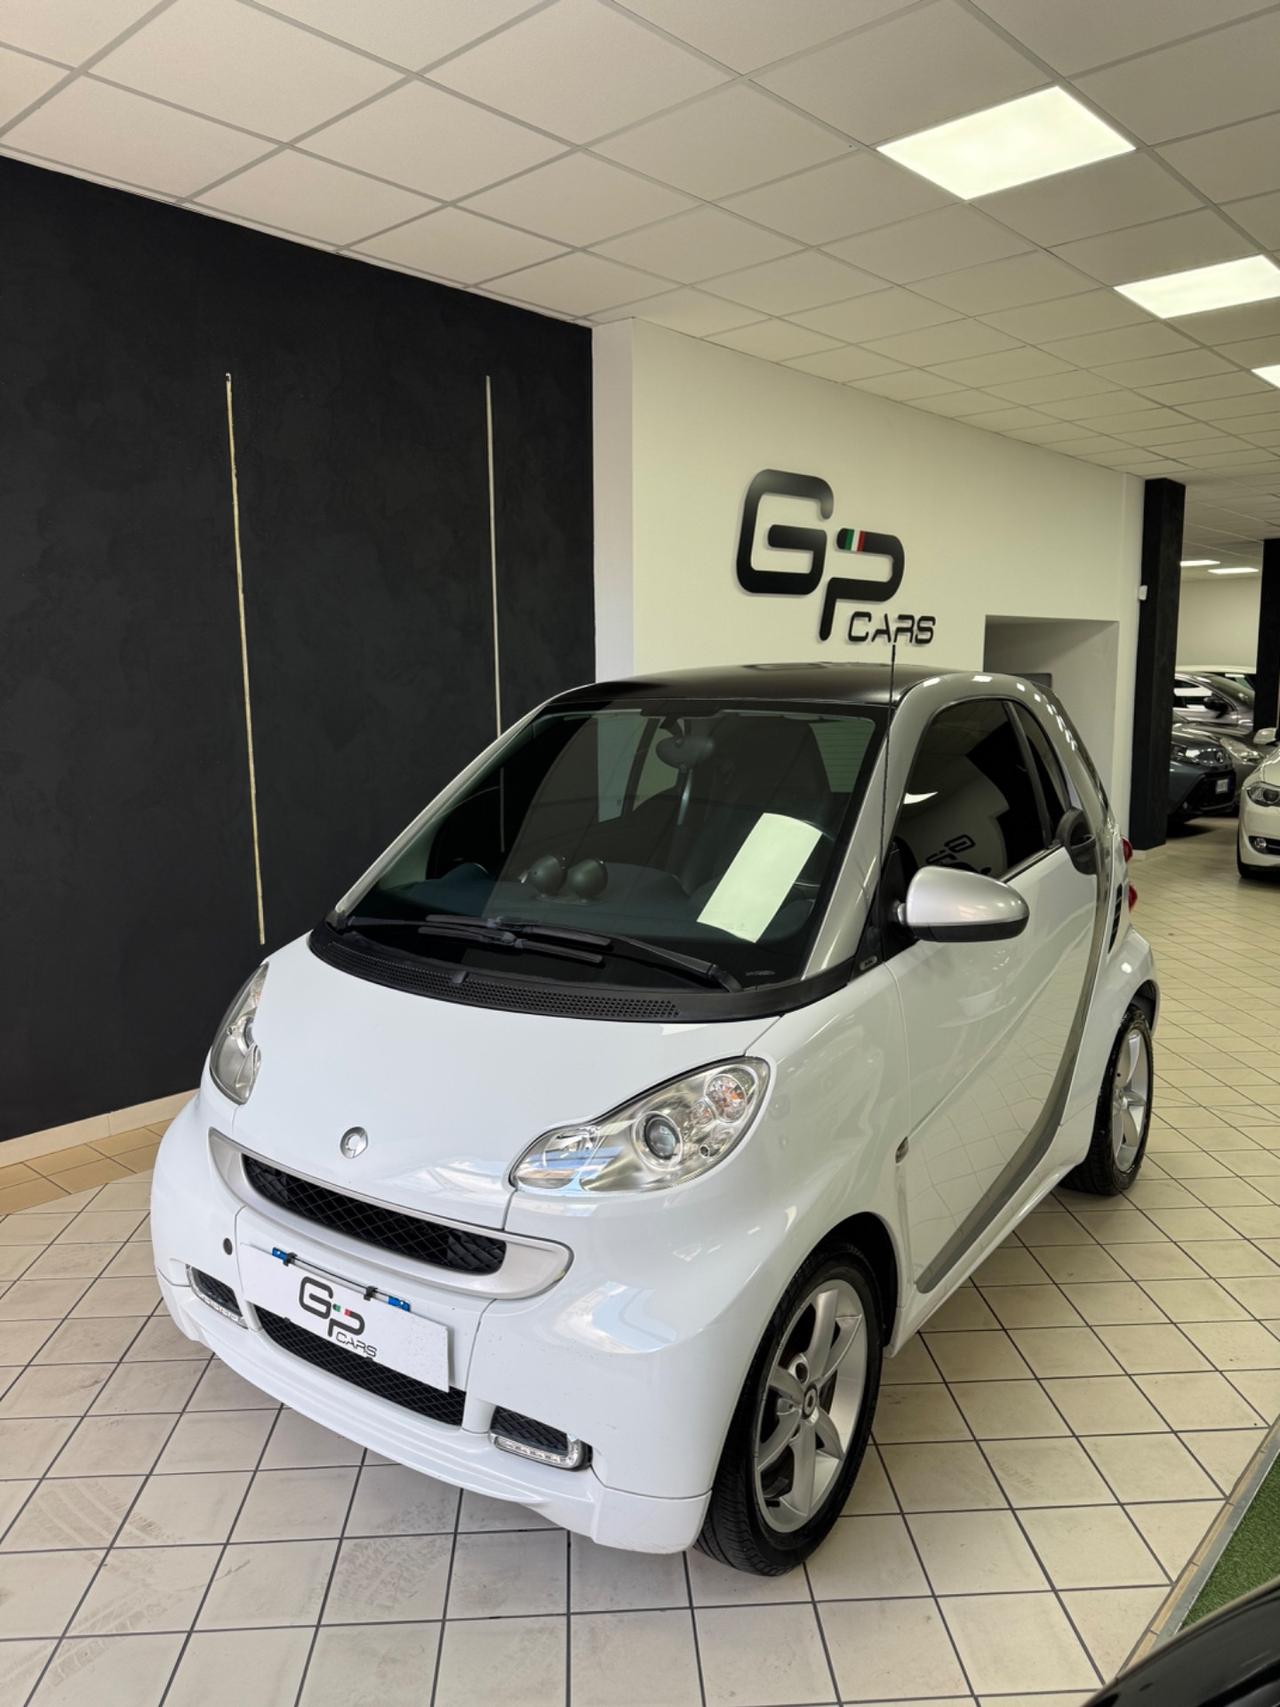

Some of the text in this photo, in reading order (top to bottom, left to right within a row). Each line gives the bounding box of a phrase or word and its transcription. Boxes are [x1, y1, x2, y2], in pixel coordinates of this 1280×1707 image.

[736, 468, 905, 641] GP
[848, 611, 936, 644] CARS
[336, 1331, 377, 1358] CARS
